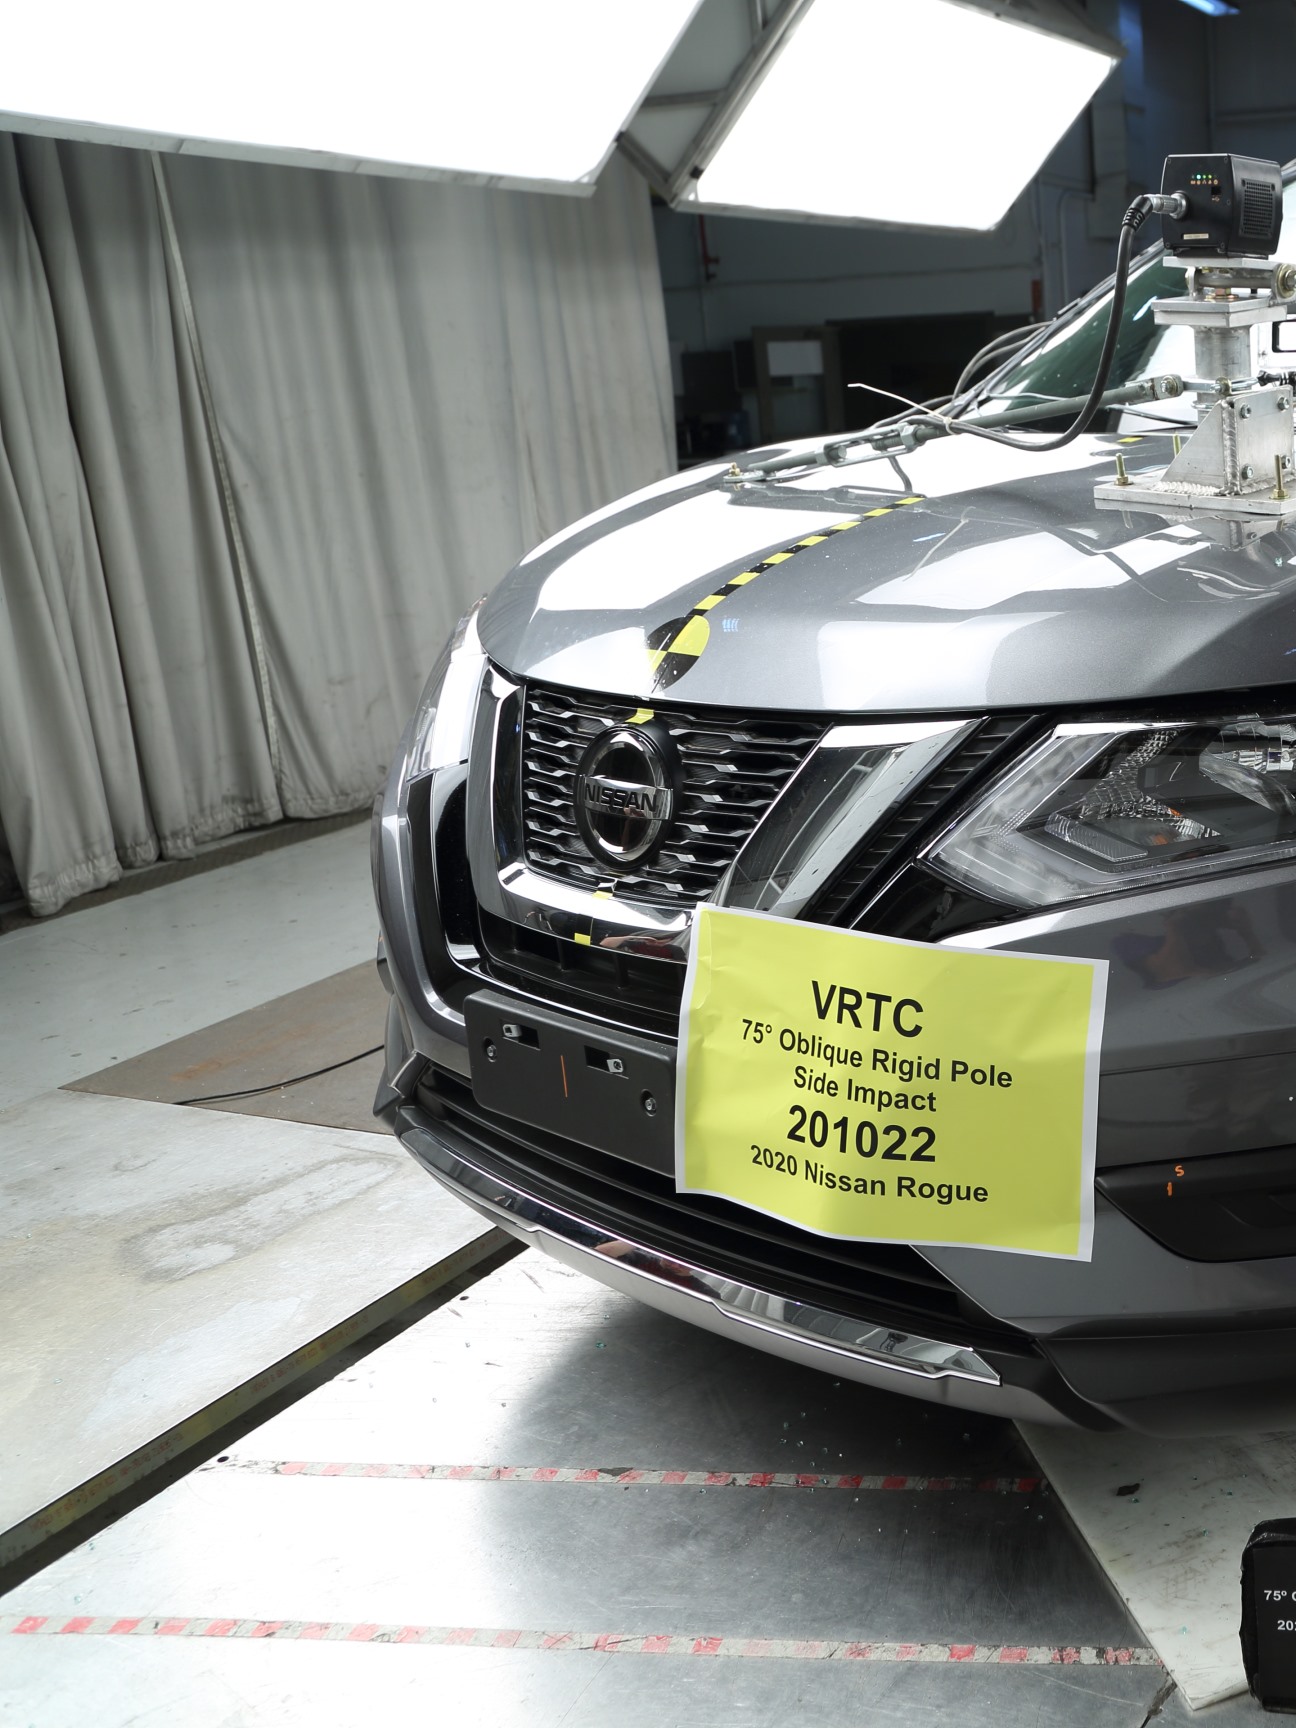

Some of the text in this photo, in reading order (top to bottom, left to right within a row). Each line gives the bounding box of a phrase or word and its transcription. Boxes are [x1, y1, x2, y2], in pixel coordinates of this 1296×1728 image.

[585, 783, 656, 813] NISSAN
[811, 980, 924, 1038] VRTC
[779, 1028, 863, 1068] Oblique
[872, 1048, 941, 1083] Rigid
[951, 1059, 1013, 1088] Pole
[793, 1065, 937, 1113] Side Impact
[786, 1104, 936, 1163] 201022
[750, 1144, 989, 1205] 2020 Nissan Rogue
